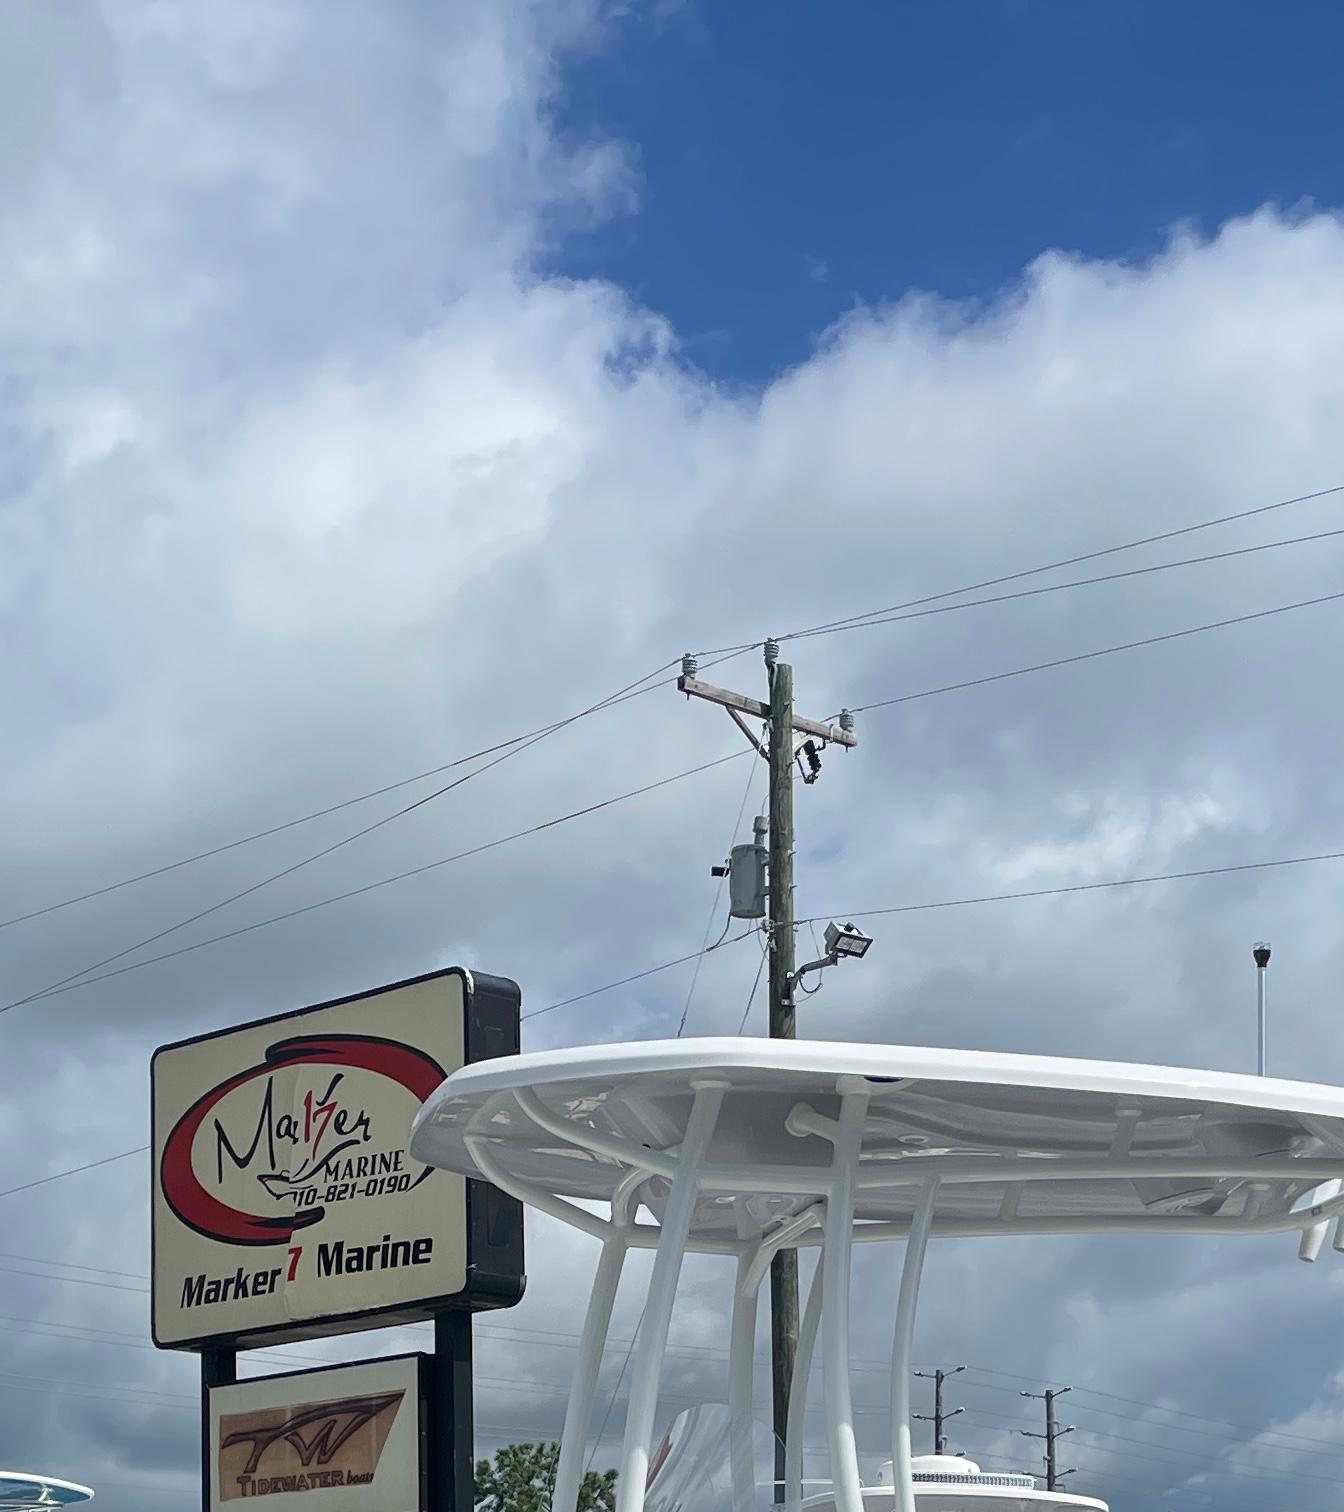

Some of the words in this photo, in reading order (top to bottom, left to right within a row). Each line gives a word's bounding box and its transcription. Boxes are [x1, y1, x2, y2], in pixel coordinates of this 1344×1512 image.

[323, 1150, 404, 1183] MARINE
[180, 1267, 282, 1309] Marker
[317, 1235, 433, 1278] Marine
[236, 1470, 345, 1497] TIDEWATER
